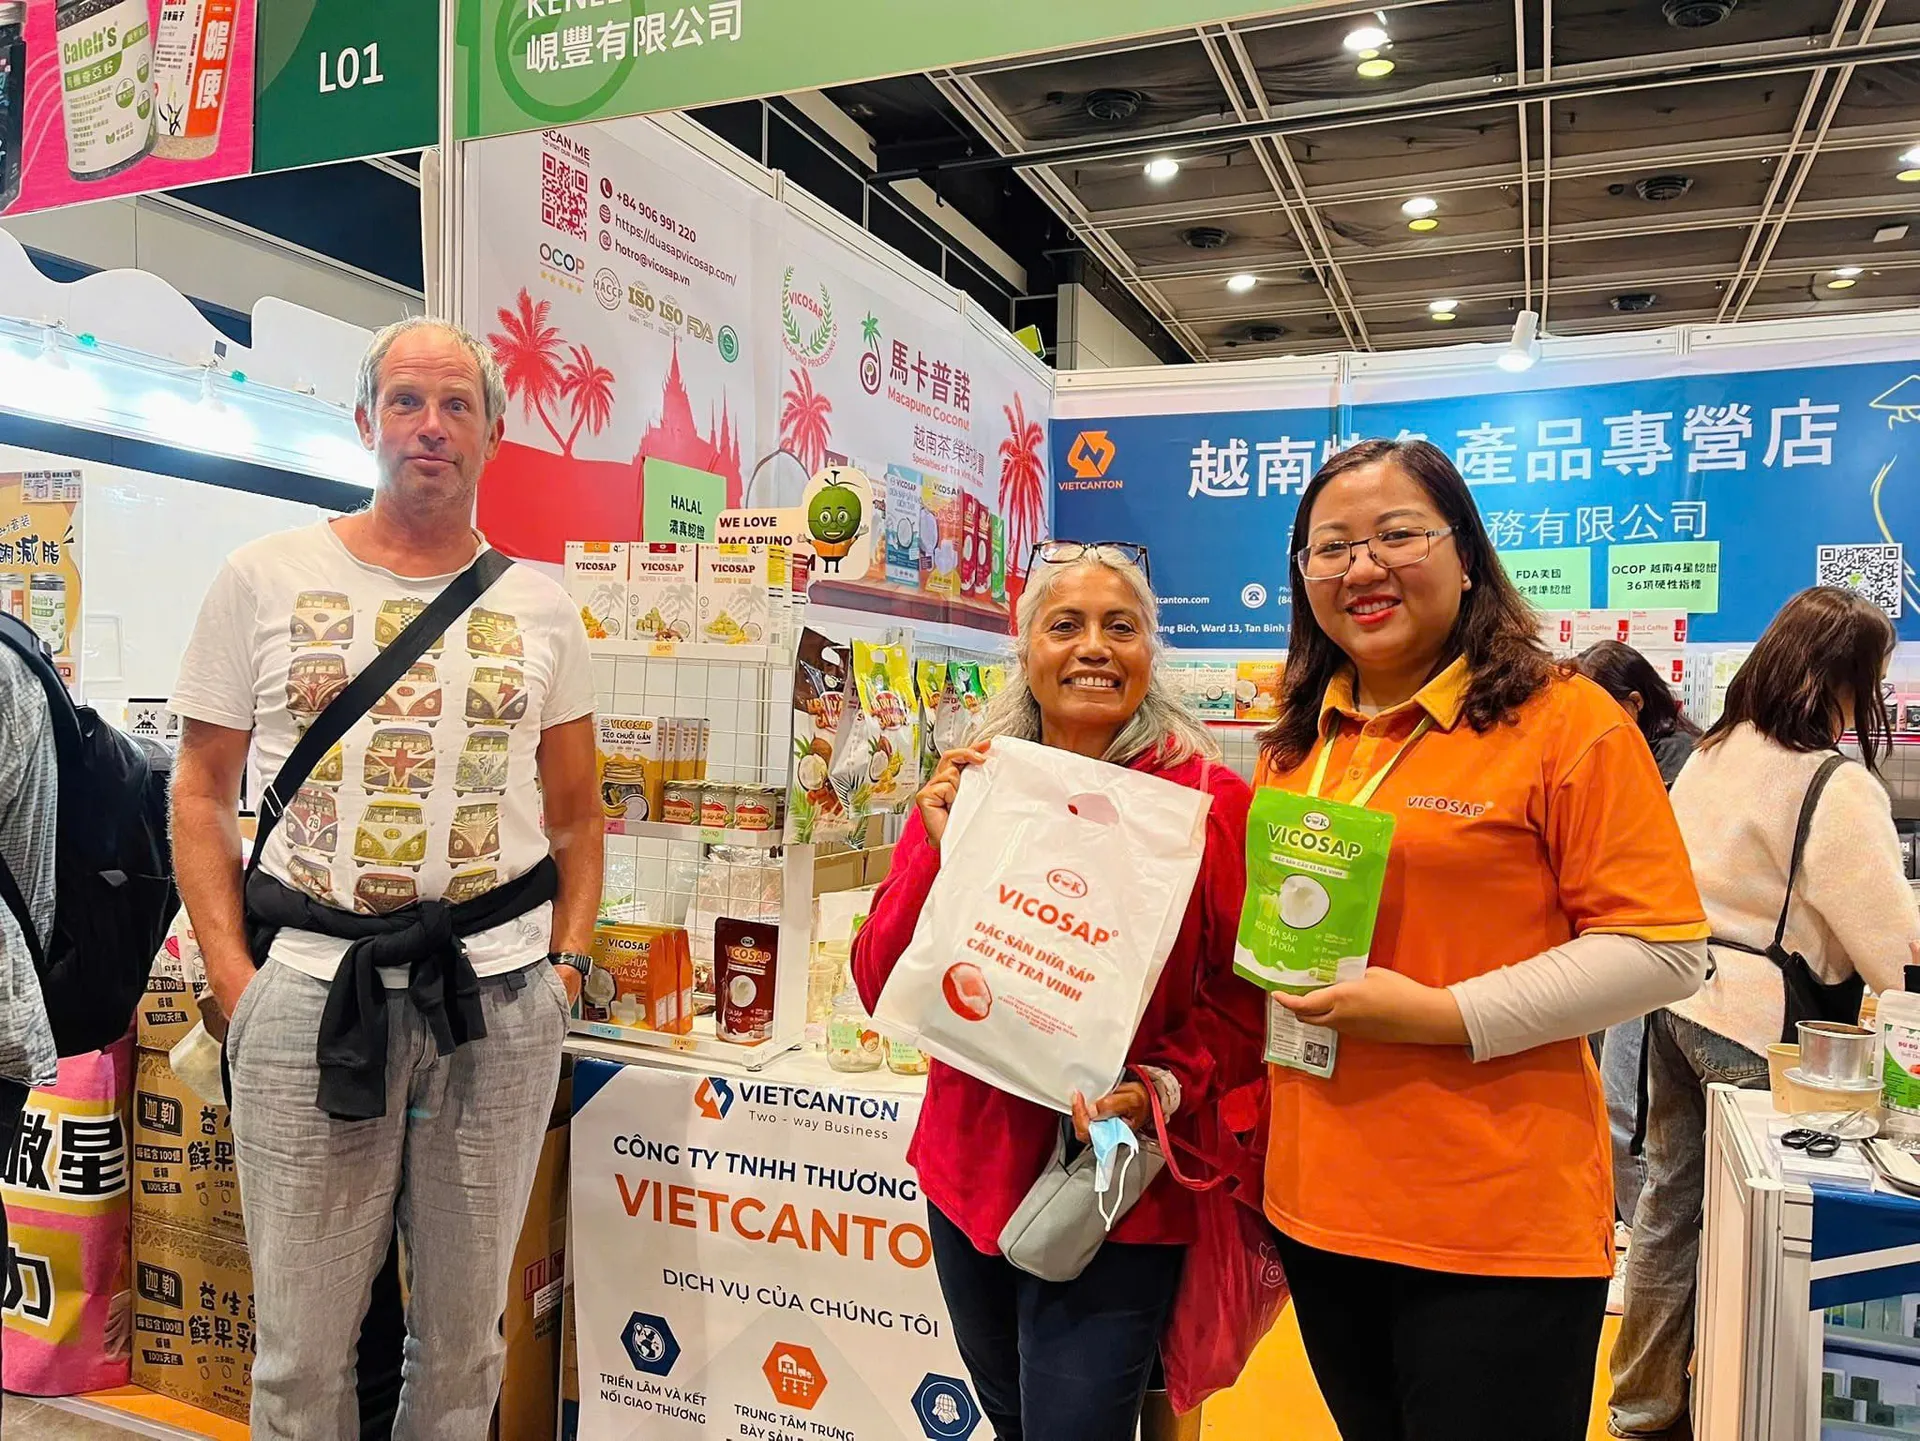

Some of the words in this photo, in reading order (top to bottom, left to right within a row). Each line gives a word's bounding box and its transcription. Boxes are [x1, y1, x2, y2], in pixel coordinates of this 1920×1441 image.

[526, 0, 742, 73] 峴豐有限公司
[574, 142, 590, 161] ME
[616, 192, 636, 212] +84
[639, 202, 657, 223] 906
[660, 213, 676, 233] 991
[678, 224, 696, 243] 220
[539, 243, 585, 275] OCOP
[615, 213, 737, 287] https://duasapvicosap.com/
[615, 239, 690, 287] hotro@vicosap.vn
[593, 279, 623, 299] HACCP
[628, 286, 655, 312] ISO
[659, 300, 683, 326] ISO
[788, 291, 824, 319] VICOSAP
[687, 315, 714, 344] FDA
[889, 339, 971, 413] 馬卡普諾
[887, 385, 932, 418] Macapuno
[1187, 397, 1840, 500] 越南產品專營店
[1057, 479, 1124, 491] VIETCANTON
[670, 494, 703, 515] HALAL
[719, 517, 740, 528] WE
[743, 516, 777, 527] LOVE
[575, 562, 617, 571] VICOSAP
[641, 562, 685, 572] VICOSAP
[710, 563, 756, 574] VICOSAP
[1515, 568, 1562, 580] FDA美國
[1611, 564, 1647, 575] OCOP
[1177, 624, 1199, 634] Bich,
[1201, 623, 1226, 633] Ward
[1228, 623, 1242, 634] 13,
[1245, 624, 1261, 633] Tan
[1263, 624, 1285, 633] Binh
[610, 719, 653, 730] VICOSAP
[1408, 796, 1484, 816] VICOSAP
[308, 817, 319, 830] 79
[1267, 823, 1362, 859] VICOSAP
[999, 884, 1111, 947] VICOSAP
[608, 938, 651, 951] VICOSAP
[1016, 961, 1045, 984] TRÀ
[1046, 976, 1083, 1002] VINH
[739, 1082, 900, 1122] VIETCANTON
[749, 1110, 777, 1124] Two
[794, 1116, 819, 1132] way
[824, 1120, 889, 1140] Business
[613, 1134, 680, 1165] CÔNG
[687, 1147, 720, 1171] TY
[725, 1152, 796, 1184] TNHH
[804, 1165, 918, 1202] THƯƠNG
[614, 1173, 932, 1269] VIETCANTO
[662, 1268, 715, 1295] DỊCH
[720, 1279, 750, 1302] VỤ
[756, 1284, 804, 1312] CỦA
[809, 1293, 894, 1329] CHÚNG
[899, 1311, 940, 1338] TÔI
[600, 1389, 621, 1403] NỐI
[623, 1395, 653, 1411] GIAO
[655, 1402, 706, 1425] THƯƠNG
[636, 1380, 661, 1396] LÃM
[664, 1387, 681, 1401] VÀ
[684, 1391, 707, 1407] KẾT
[734, 1404, 777, 1424] TRUNG
[780, 1414, 807, 1432] TÂM
[810, 1422, 855, 1441] TRƯNG
[740, 1423, 765, 1439] BÀY
